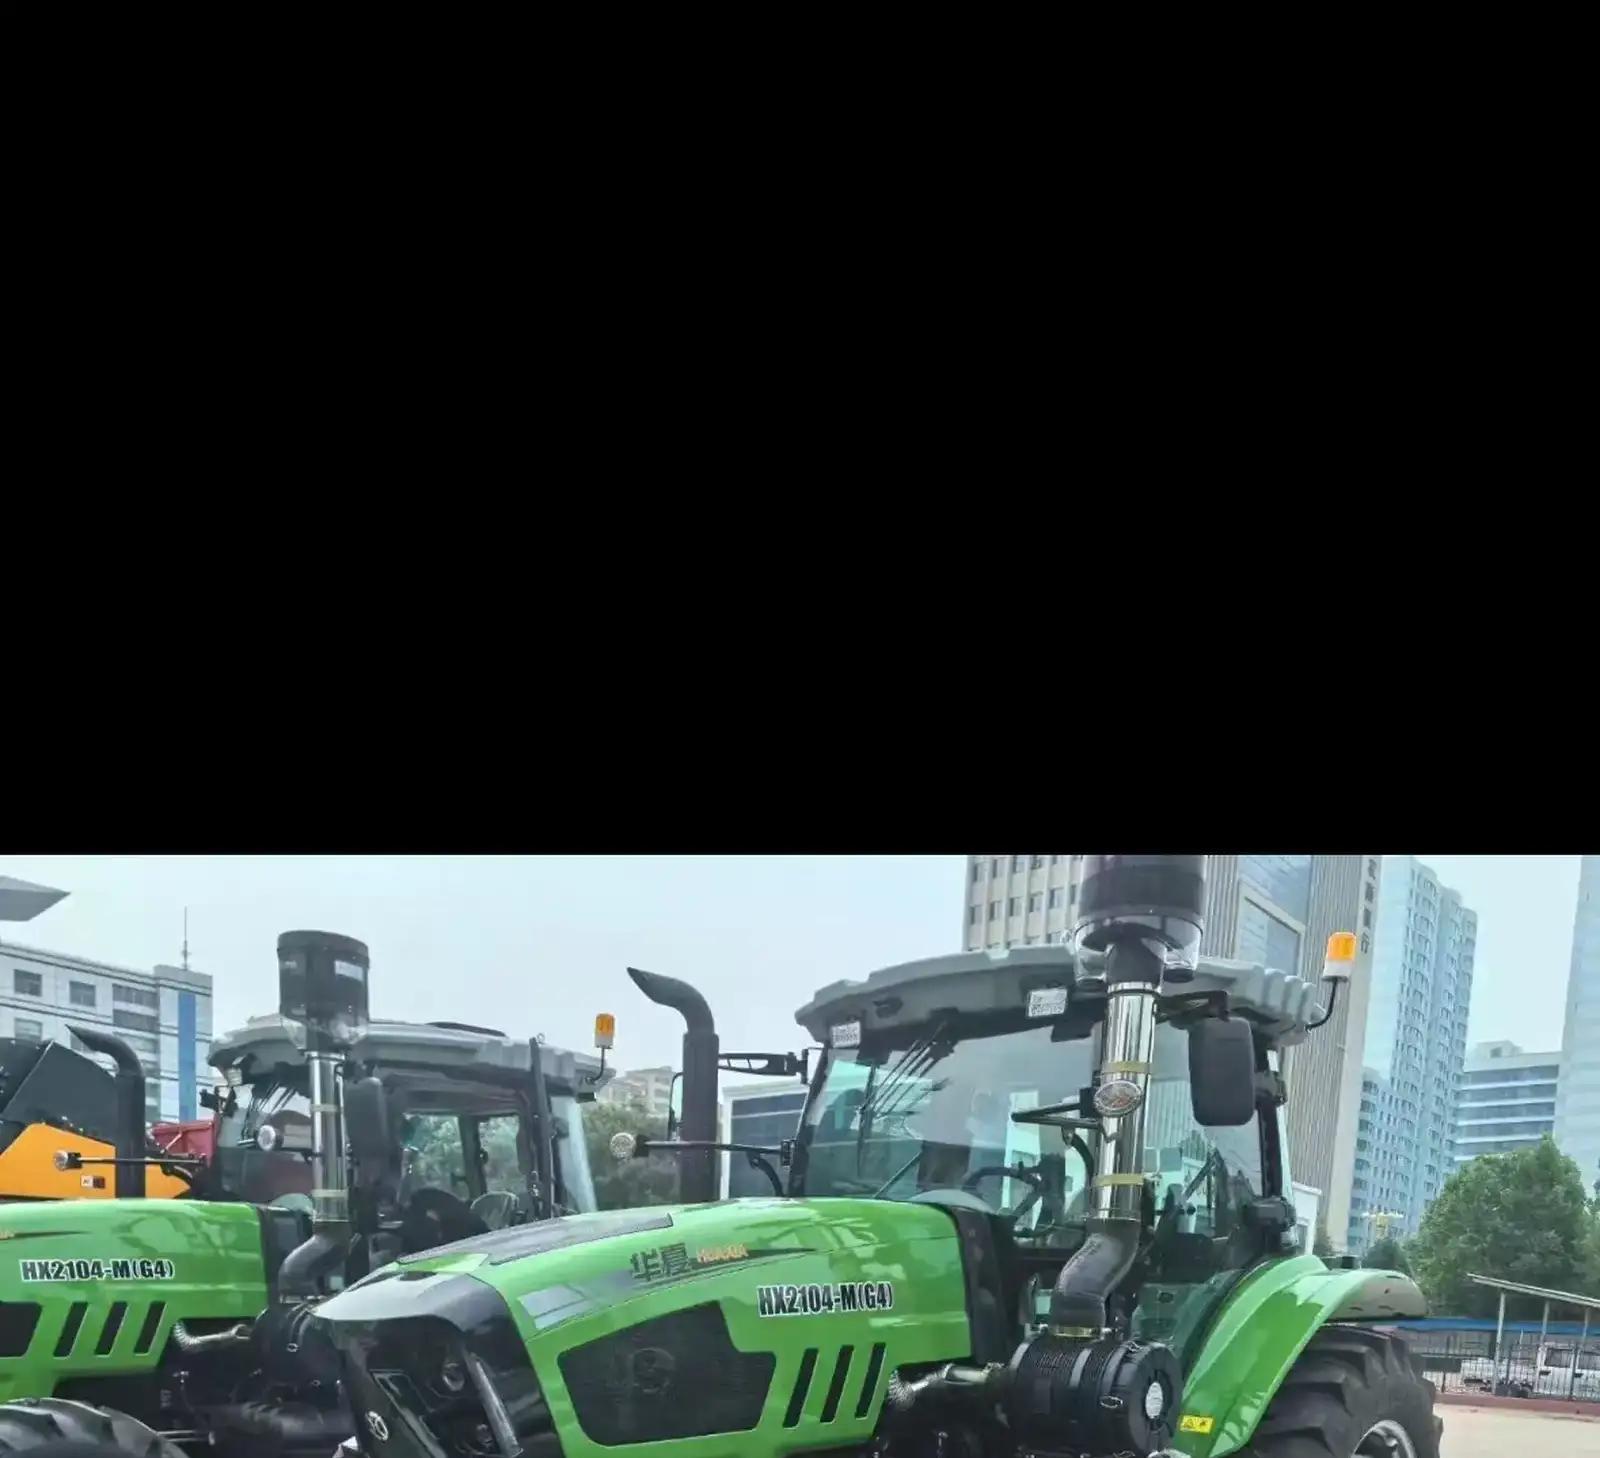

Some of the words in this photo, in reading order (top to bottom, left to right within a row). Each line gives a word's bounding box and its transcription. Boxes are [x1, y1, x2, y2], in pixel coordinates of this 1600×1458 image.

[20, 1259, 174, 1281] HX2104-M(G4)
[630, 1242, 692, 1281] 华夏
[757, 1282, 893, 1316] HX2104-M(G4)
